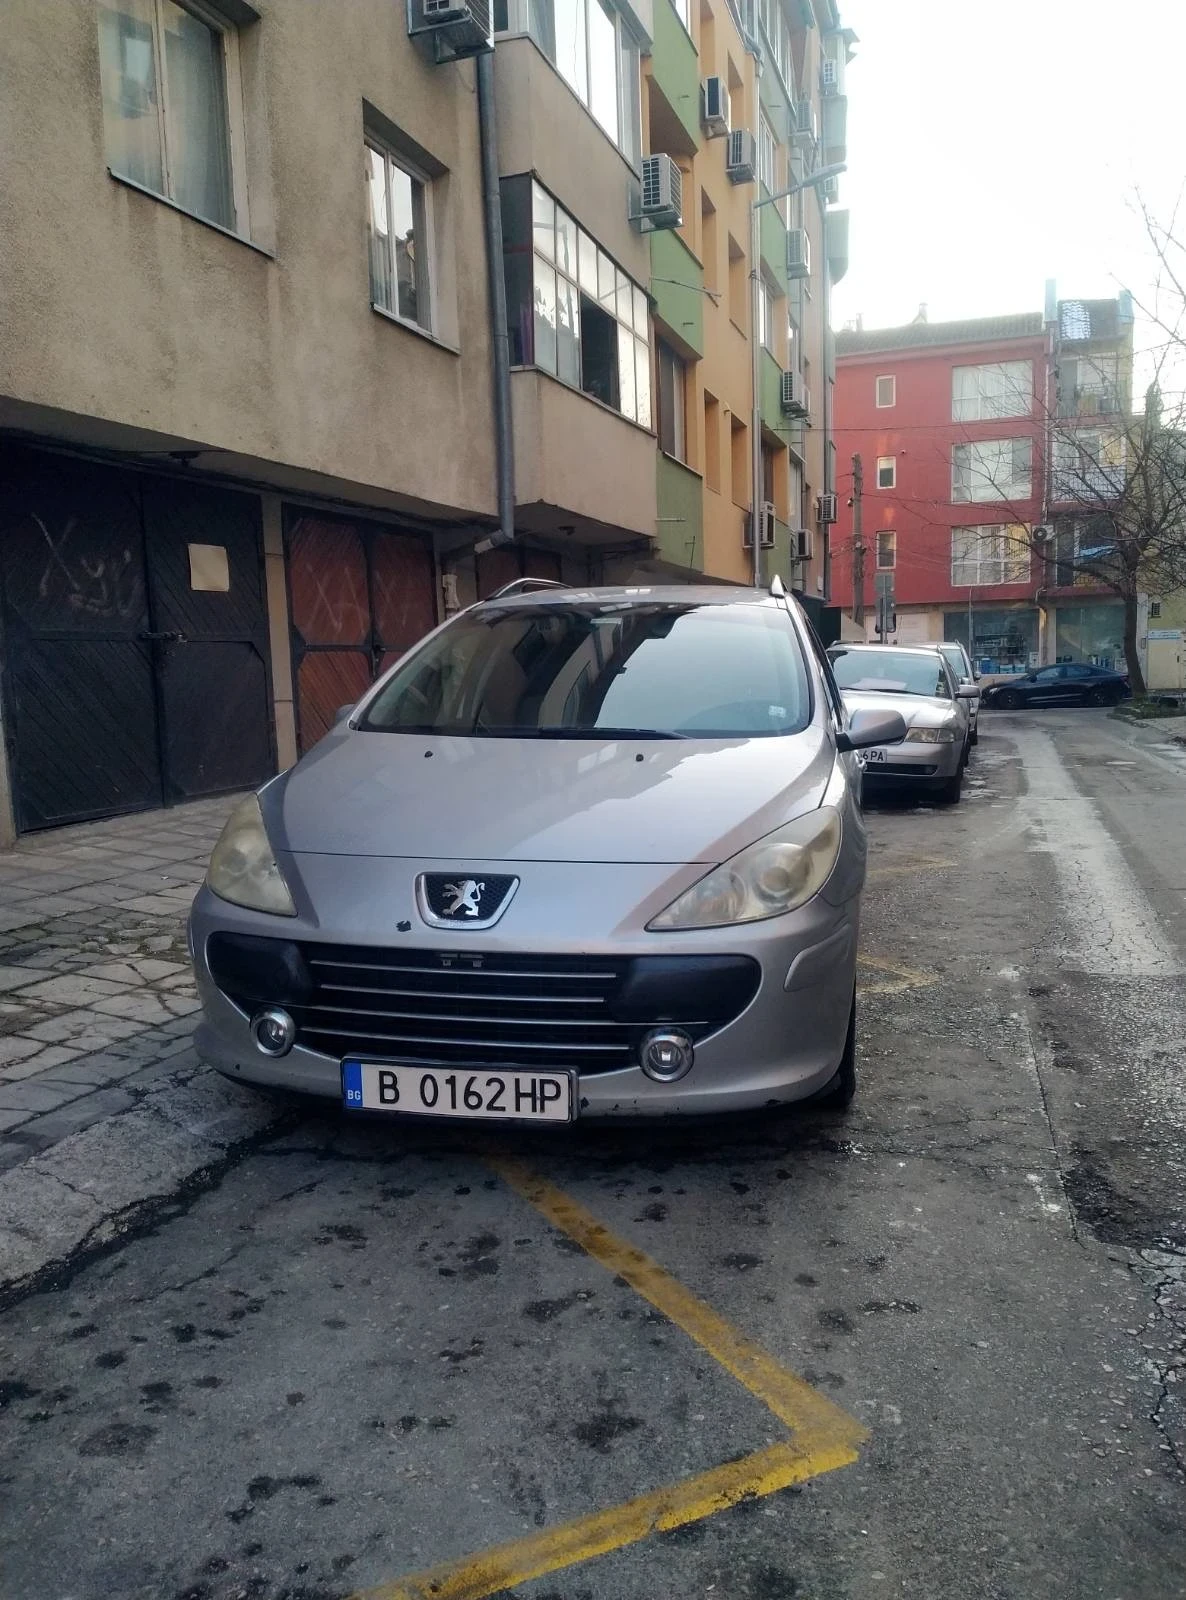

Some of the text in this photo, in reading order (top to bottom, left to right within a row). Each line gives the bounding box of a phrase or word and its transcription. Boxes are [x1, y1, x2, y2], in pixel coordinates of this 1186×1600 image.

[860, 750, 884, 761] 6PA
[379, 1070, 400, 1104] B
[347, 1089, 361, 1100] BG
